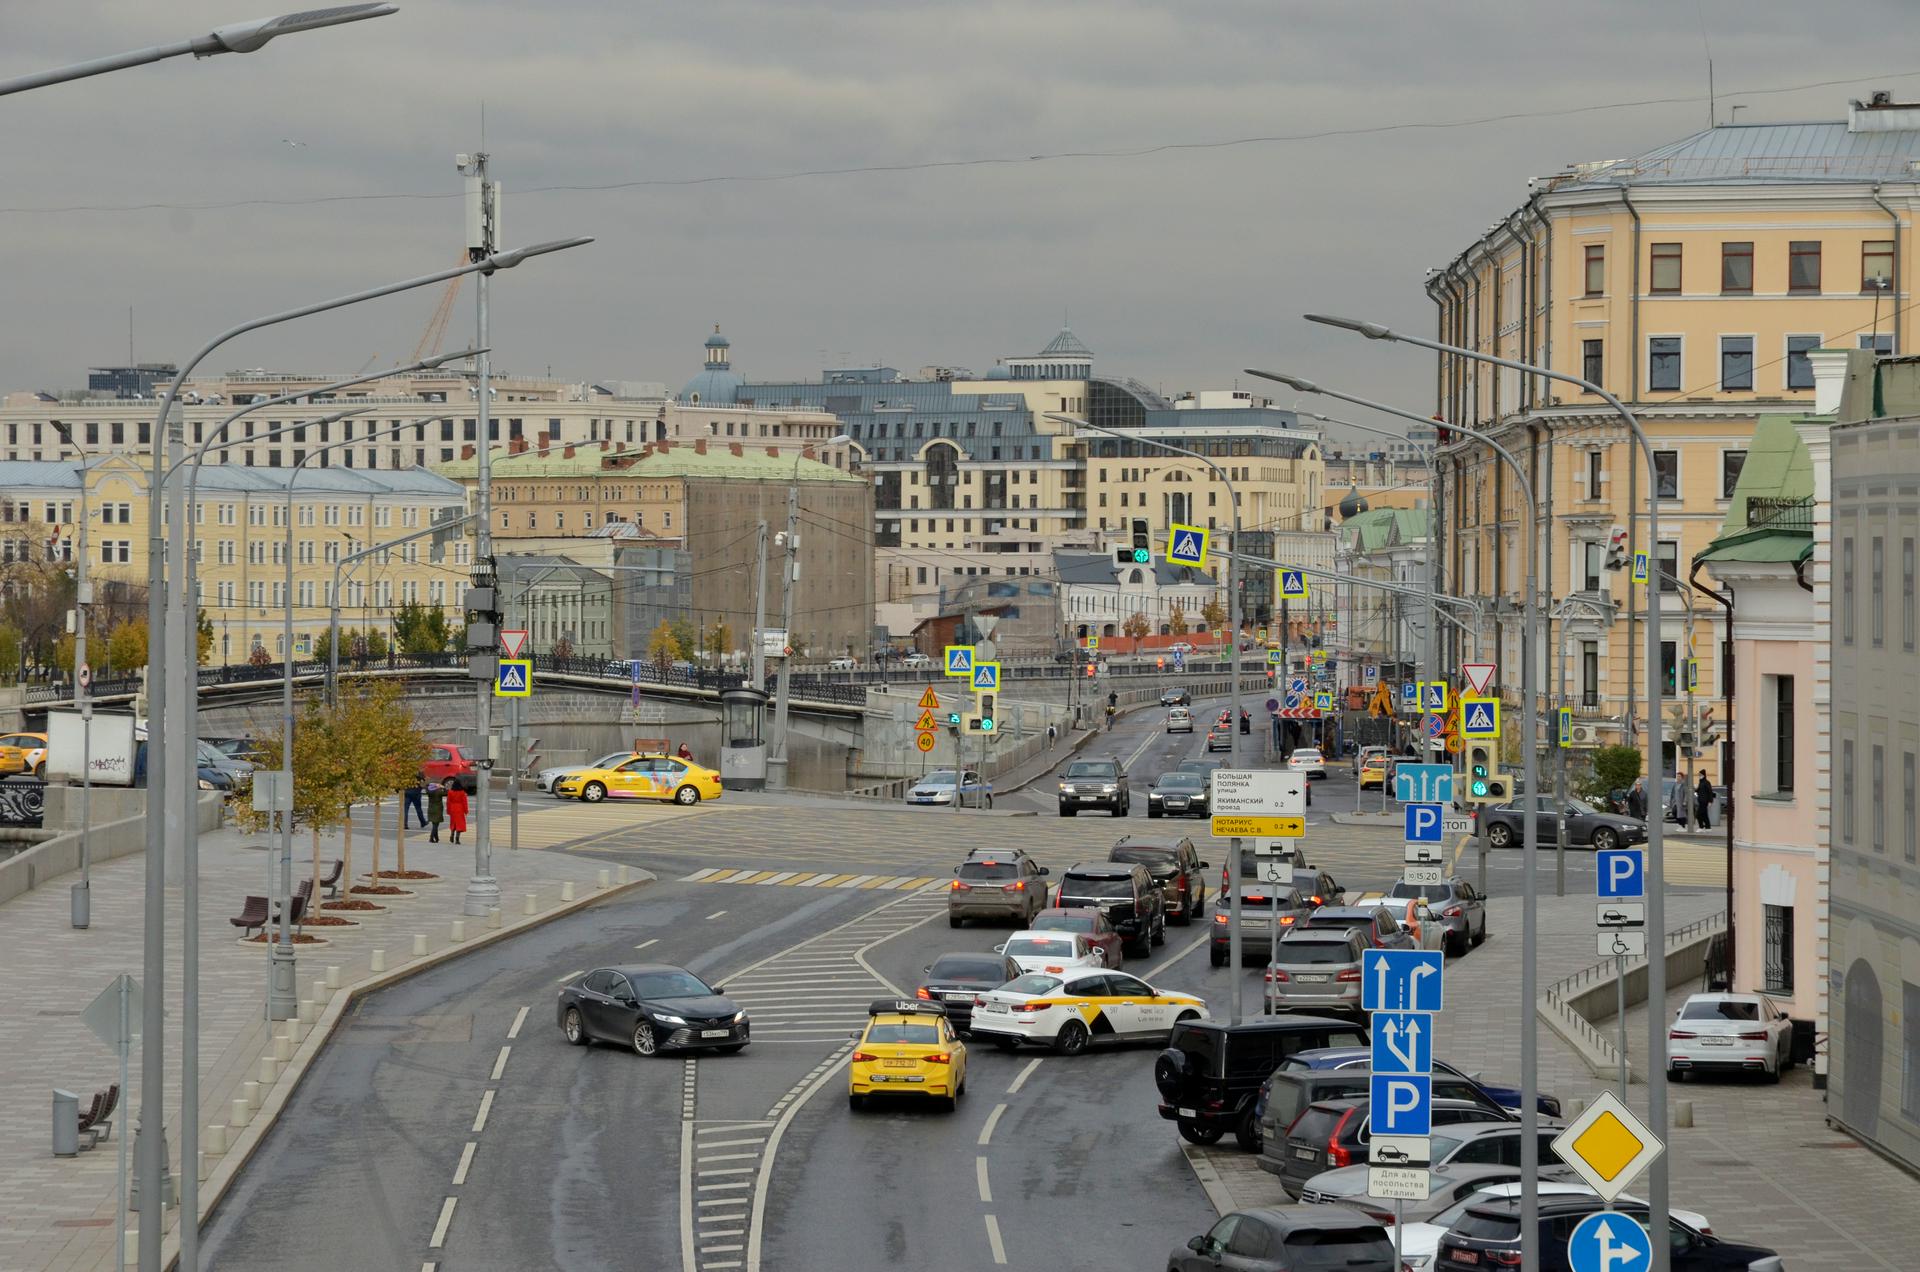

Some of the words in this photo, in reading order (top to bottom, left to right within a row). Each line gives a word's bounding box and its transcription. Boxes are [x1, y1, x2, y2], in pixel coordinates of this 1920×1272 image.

[1368, 668, 1374, 676] P
[1405, 685, 1414, 697] P
[921, 738, 931, 747] 40
[1415, 808, 1437, 838] P
[1426, 872, 1438, 880] 20
[1609, 855, 1635, 893] P
[895, 1001, 919, 1010] Uber
[1387, 1081, 1420, 1128] P
[1381, 1170, 1398, 1178] Для
[1401, 1170, 1417, 1178] а/м
[1373, 1180, 1424, 1188] посольства
[1382, 1189, 1416, 1197] Италии
